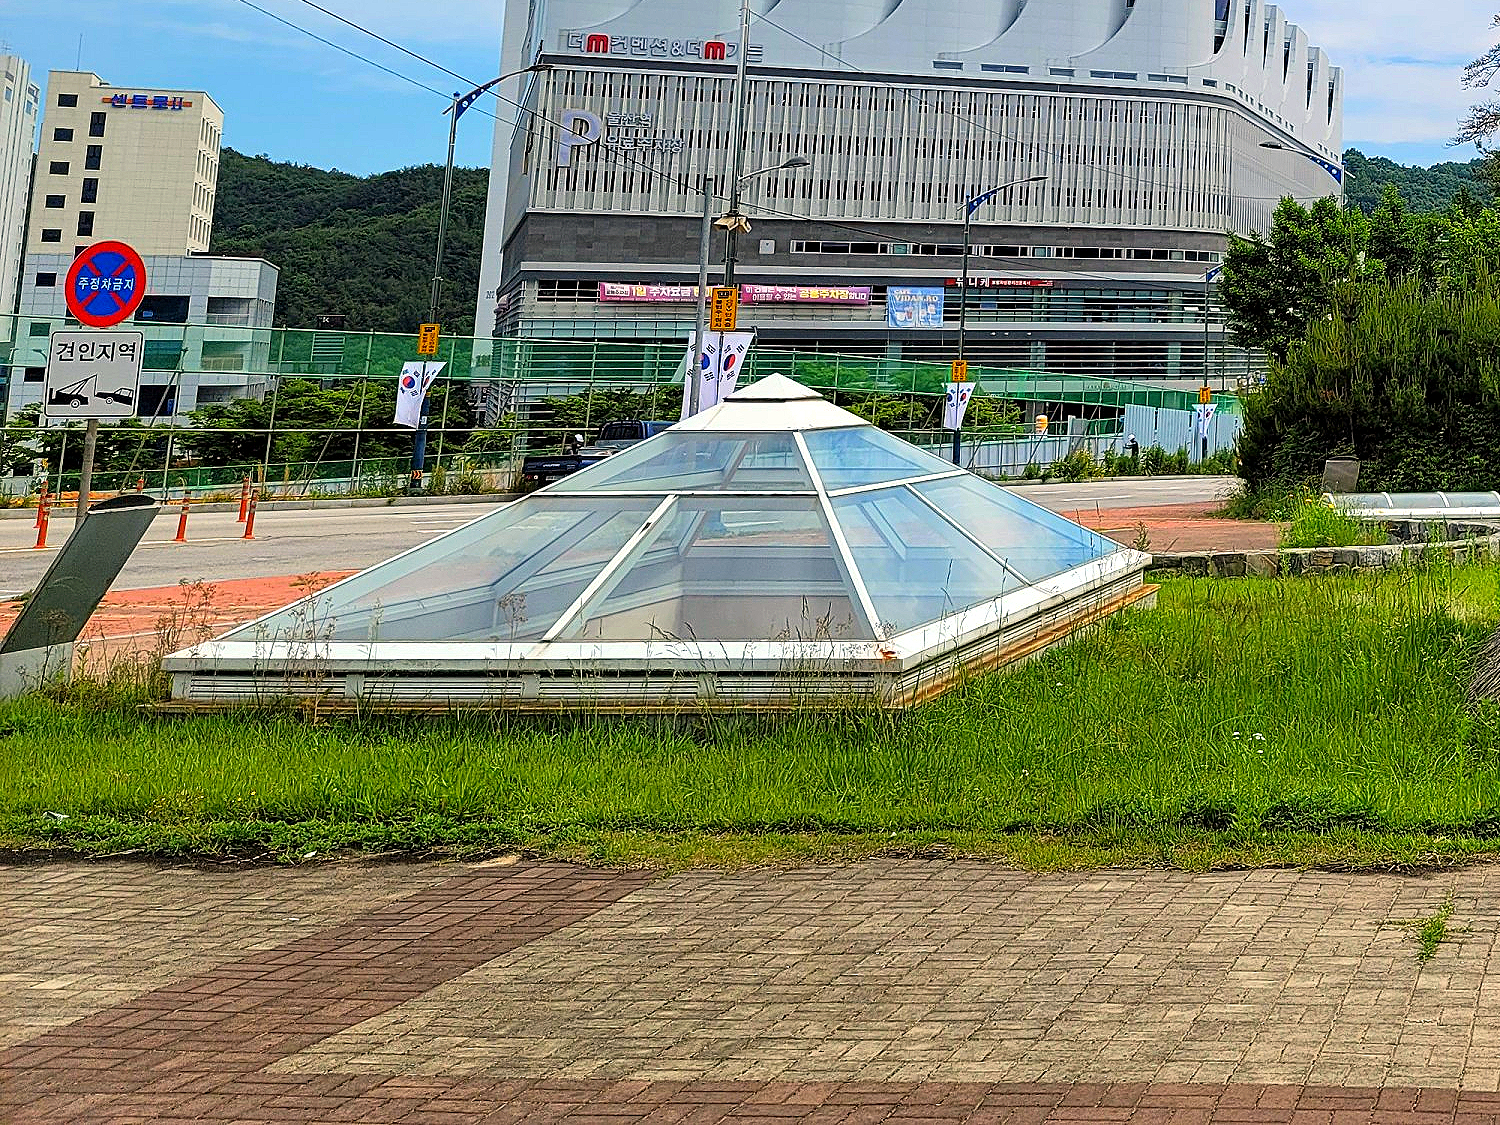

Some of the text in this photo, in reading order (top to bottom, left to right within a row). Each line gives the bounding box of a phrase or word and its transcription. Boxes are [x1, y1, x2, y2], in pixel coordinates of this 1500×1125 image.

[78, 277, 135, 291] 주정차금지
[649, 286, 692, 297] 주차요금
[56, 341, 137, 362] 견인지역
